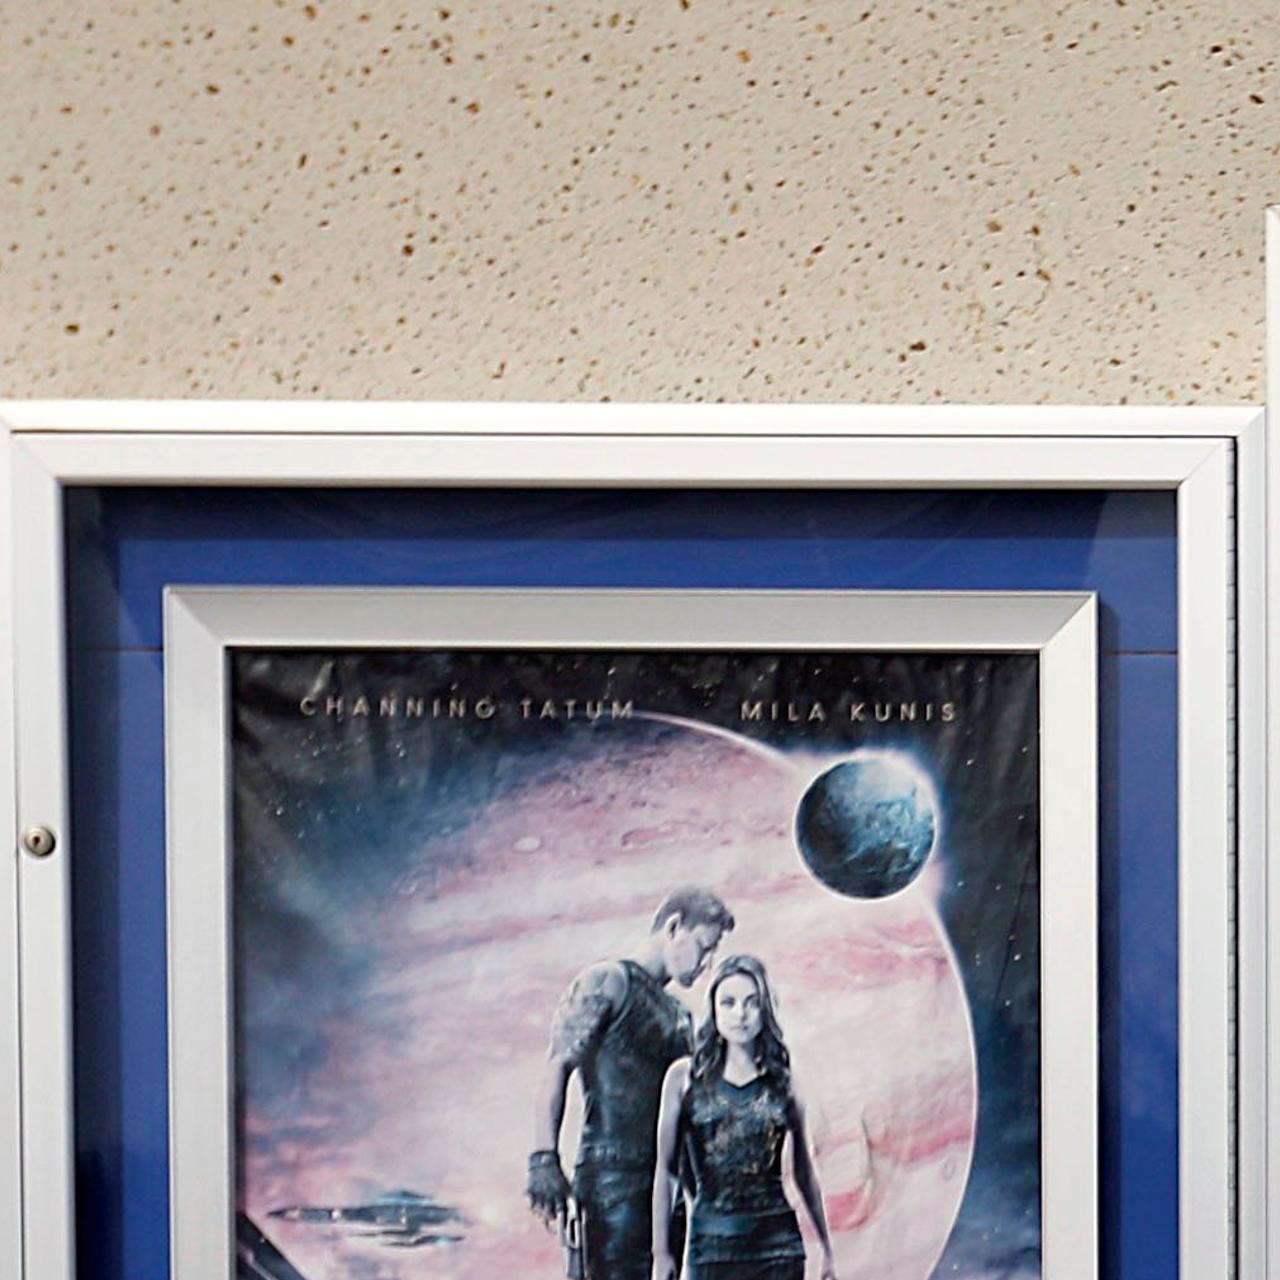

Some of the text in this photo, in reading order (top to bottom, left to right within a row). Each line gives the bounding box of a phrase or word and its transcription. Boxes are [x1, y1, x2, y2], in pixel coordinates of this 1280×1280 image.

[299, 696, 634, 720] CHANNING TATUM
[740, 699, 957, 722] MILA KUNIS
